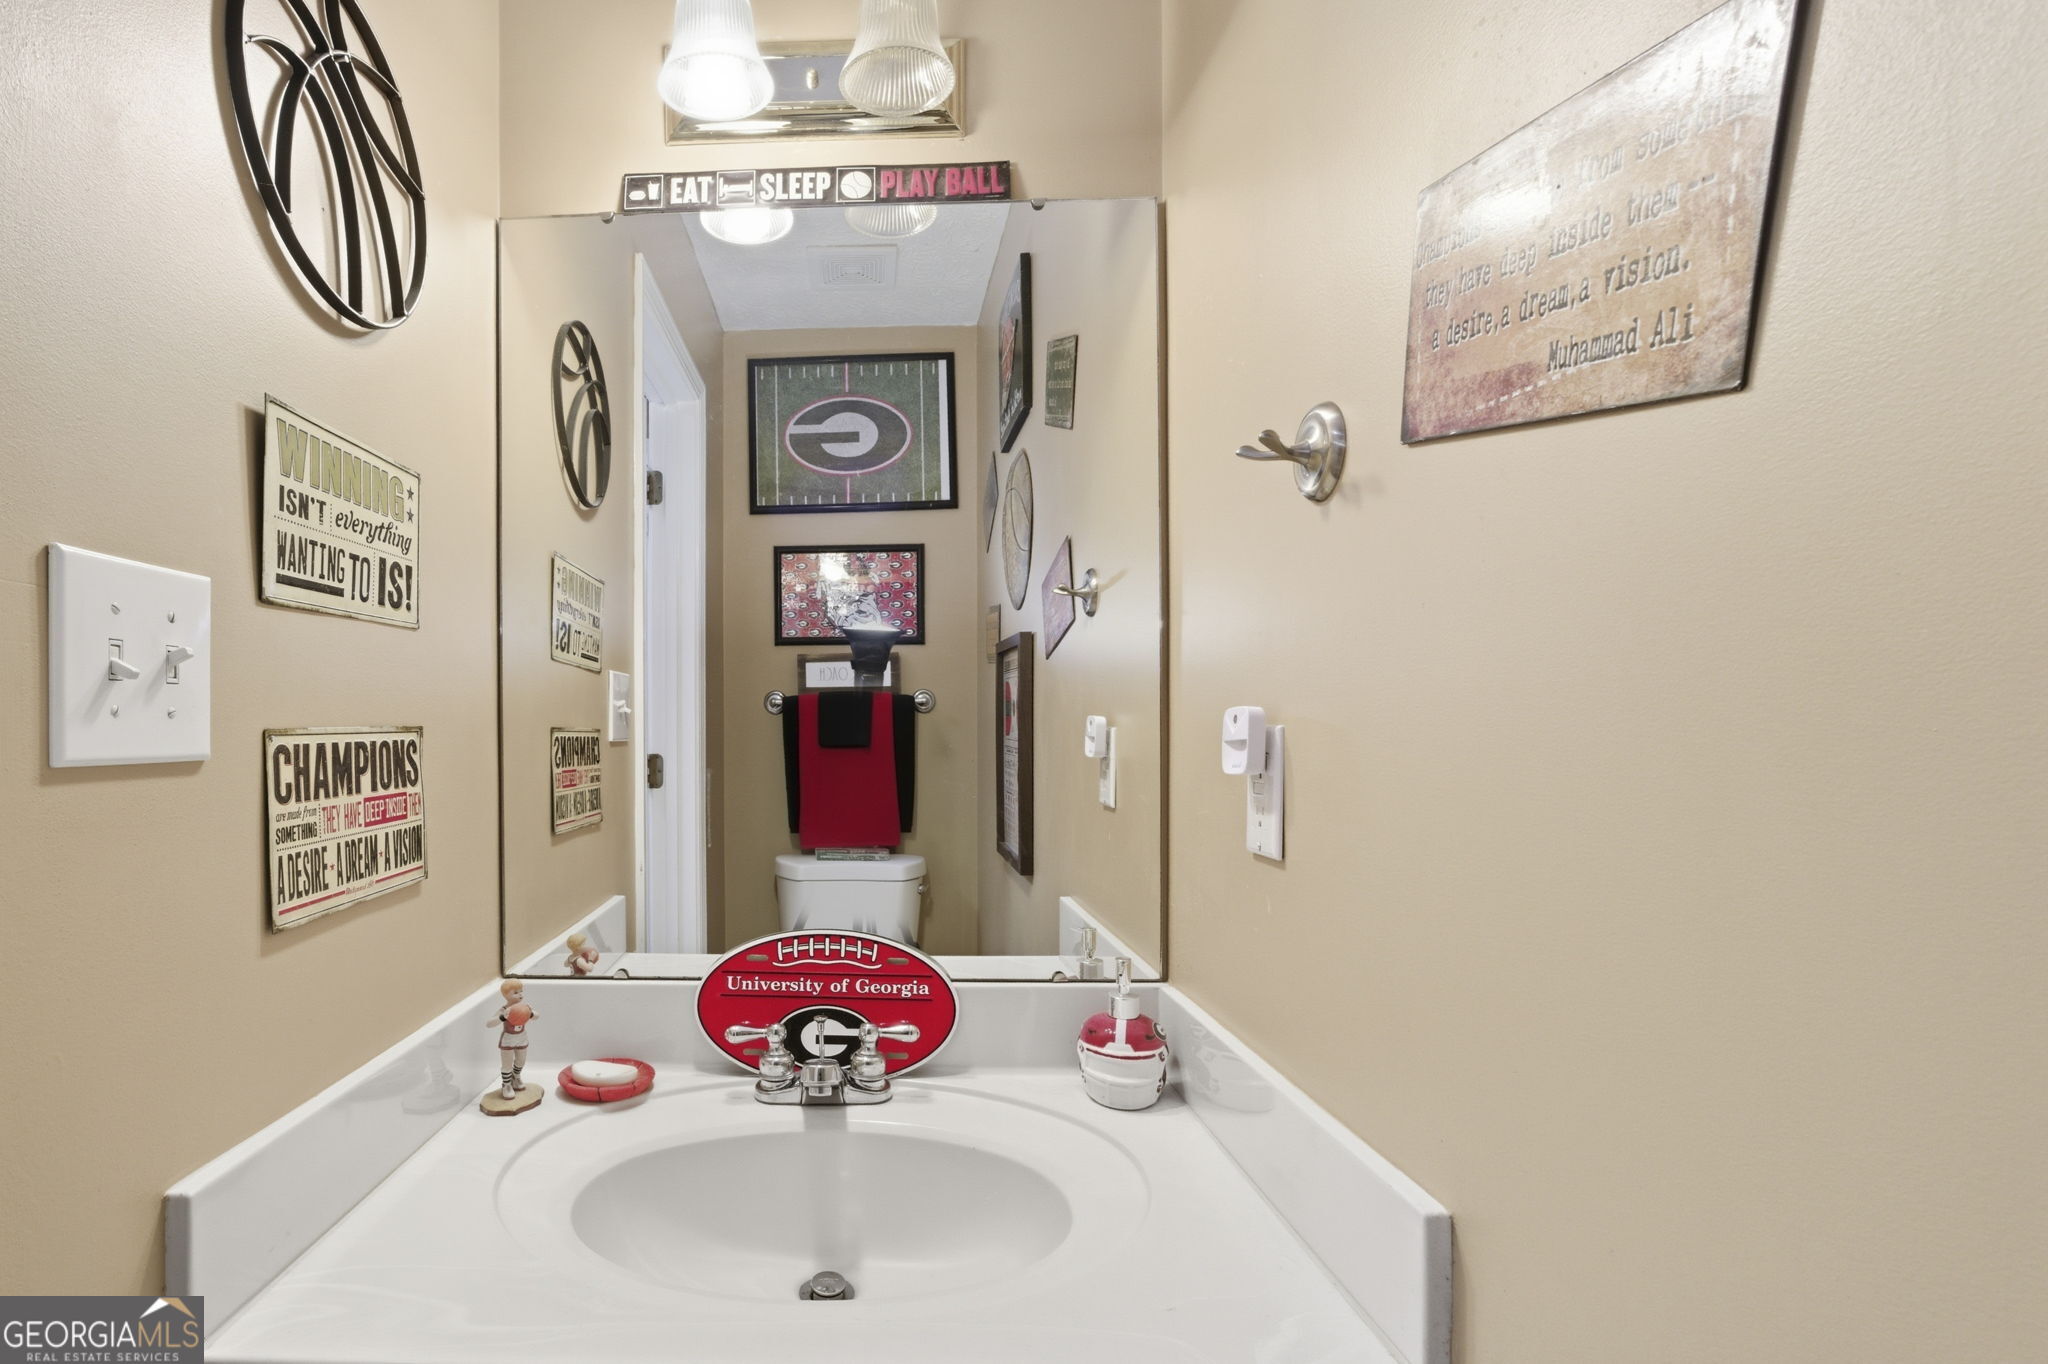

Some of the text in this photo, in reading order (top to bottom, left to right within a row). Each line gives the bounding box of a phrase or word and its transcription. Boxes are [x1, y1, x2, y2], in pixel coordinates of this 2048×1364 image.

[670, 165, 1004, 204] EAT SLEEP PLAY BALL
[1425, 280, 1454, 311] they
[1458, 264, 1492, 294] have
[1500, 243, 1538, 279] deep
[1549, 212, 1612, 260] inside
[1628, 181, 1680, 224] them
[1432, 329, 1440, 351] a
[1604, 243, 1690, 294] vision.
[1547, 303, 1695, 373] Muhammad Ali
[276, 417, 405, 523] WINNING
[278, 484, 413, 556] ISN'T everything
[276, 529, 413, 612] WANTING TO IS!
[272, 738, 419, 805] CHAMPIONS
[275, 821, 318, 845] SOMETHING
[321, 804, 341, 835] THEY
[343, 801, 362, 830] HAVE
[364, 799, 385, 822] DEEP
[386, 795, 407, 819] INSIDE
[277, 824, 422, 905] A DESIRE A DREAM A VISION
[726, 975, 930, 998] University of Georgia
